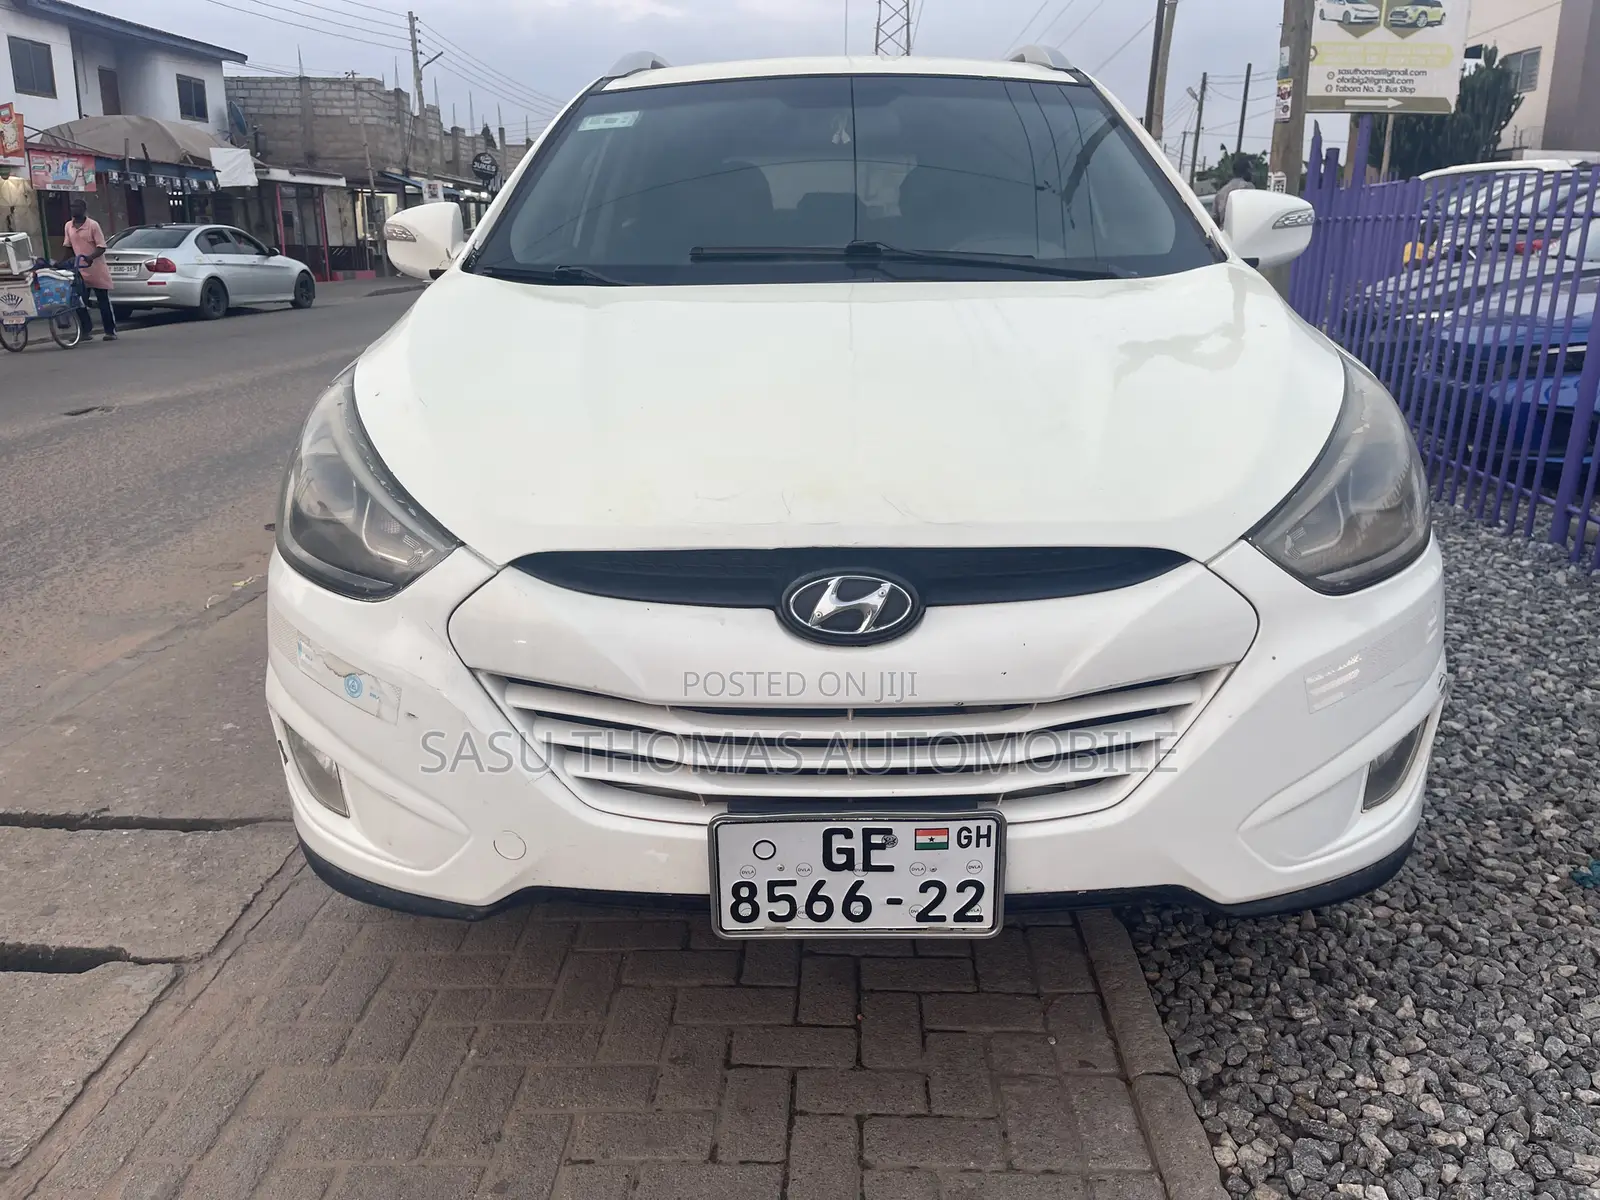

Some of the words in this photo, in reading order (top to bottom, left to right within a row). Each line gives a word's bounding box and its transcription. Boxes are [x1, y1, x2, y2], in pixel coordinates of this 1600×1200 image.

[473, 161, 496, 172] JUKES
[822, 826, 895, 872] GE
[956, 824, 992, 849] GH
